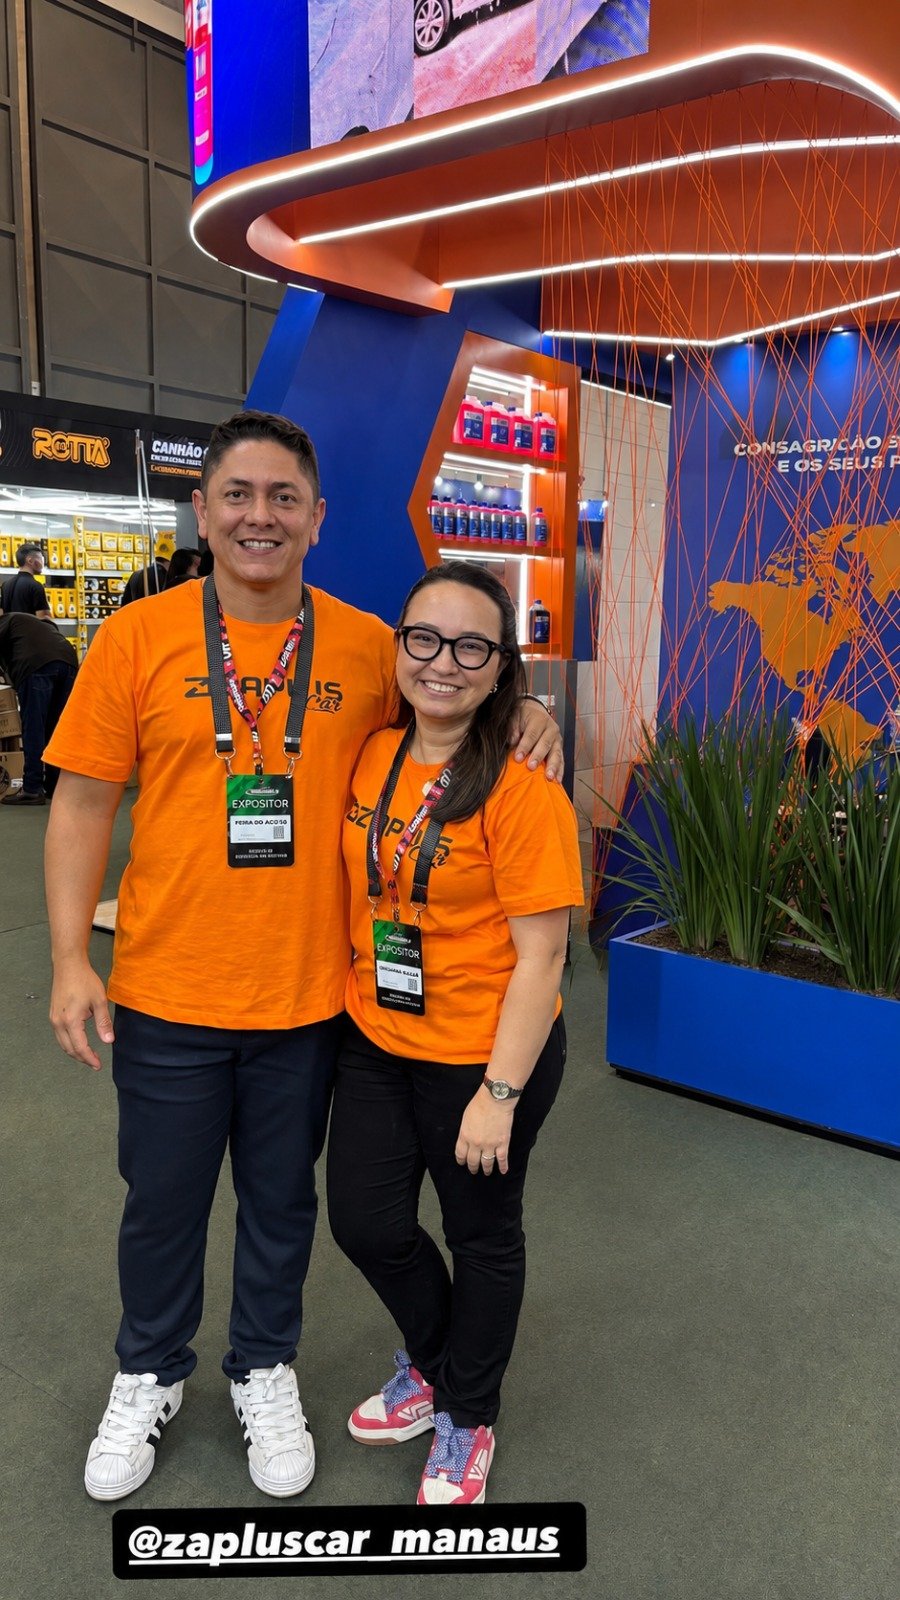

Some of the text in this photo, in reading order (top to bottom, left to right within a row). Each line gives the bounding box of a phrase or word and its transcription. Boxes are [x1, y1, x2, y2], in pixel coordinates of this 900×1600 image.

[32, 427, 110, 468] ROTTA
[152, 440, 203, 458] CANHÃO
[777, 460, 790, 473] E
[794, 458, 823, 472] OS
[828, 455, 883, 471] SEUS
[232, 799, 288, 809] EXPOSITOR
[377, 942, 420, 959] EXPOSITOR
